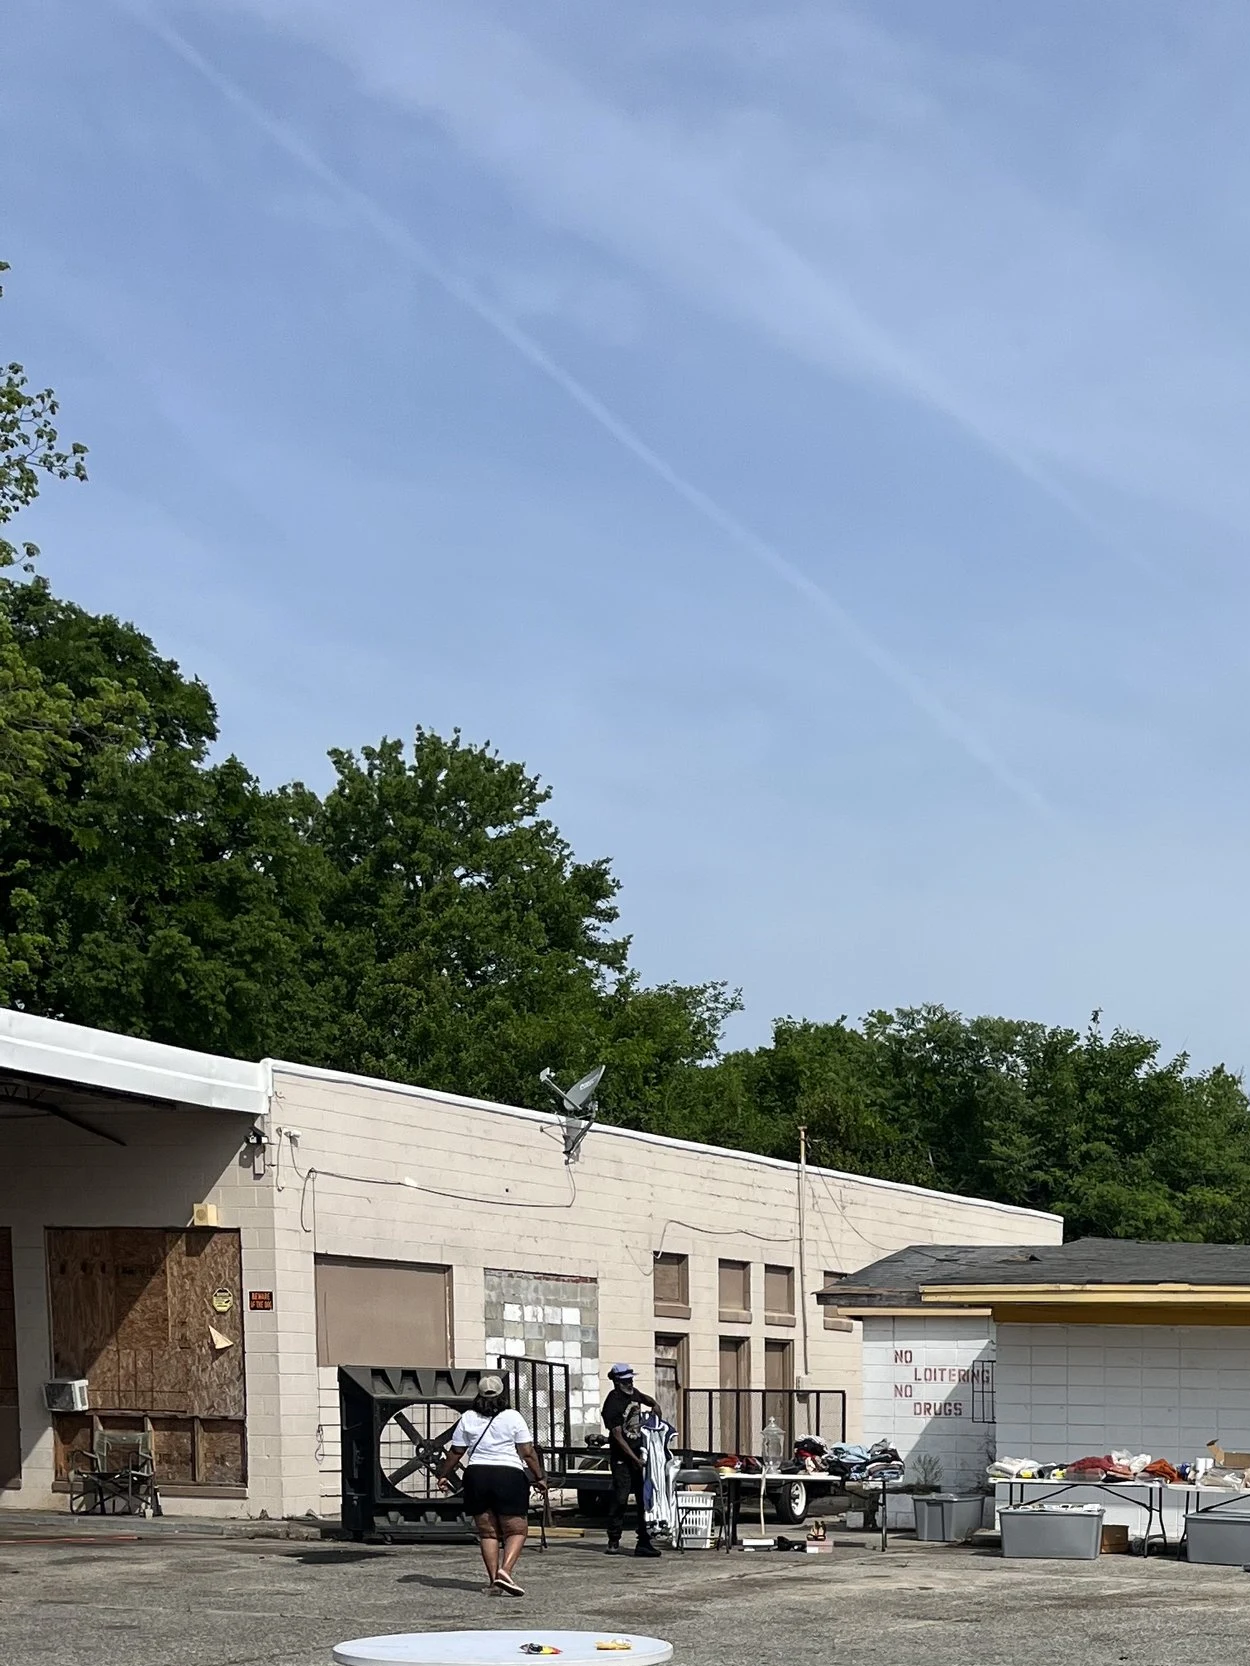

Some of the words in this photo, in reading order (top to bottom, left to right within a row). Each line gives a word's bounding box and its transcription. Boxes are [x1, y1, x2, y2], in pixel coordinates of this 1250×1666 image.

[894, 1349, 913, 1364] NO
[914, 1367, 991, 1384] LOITERING
[894, 1384, 913, 1398] NO
[913, 1401, 963, 1416] DRUGS
